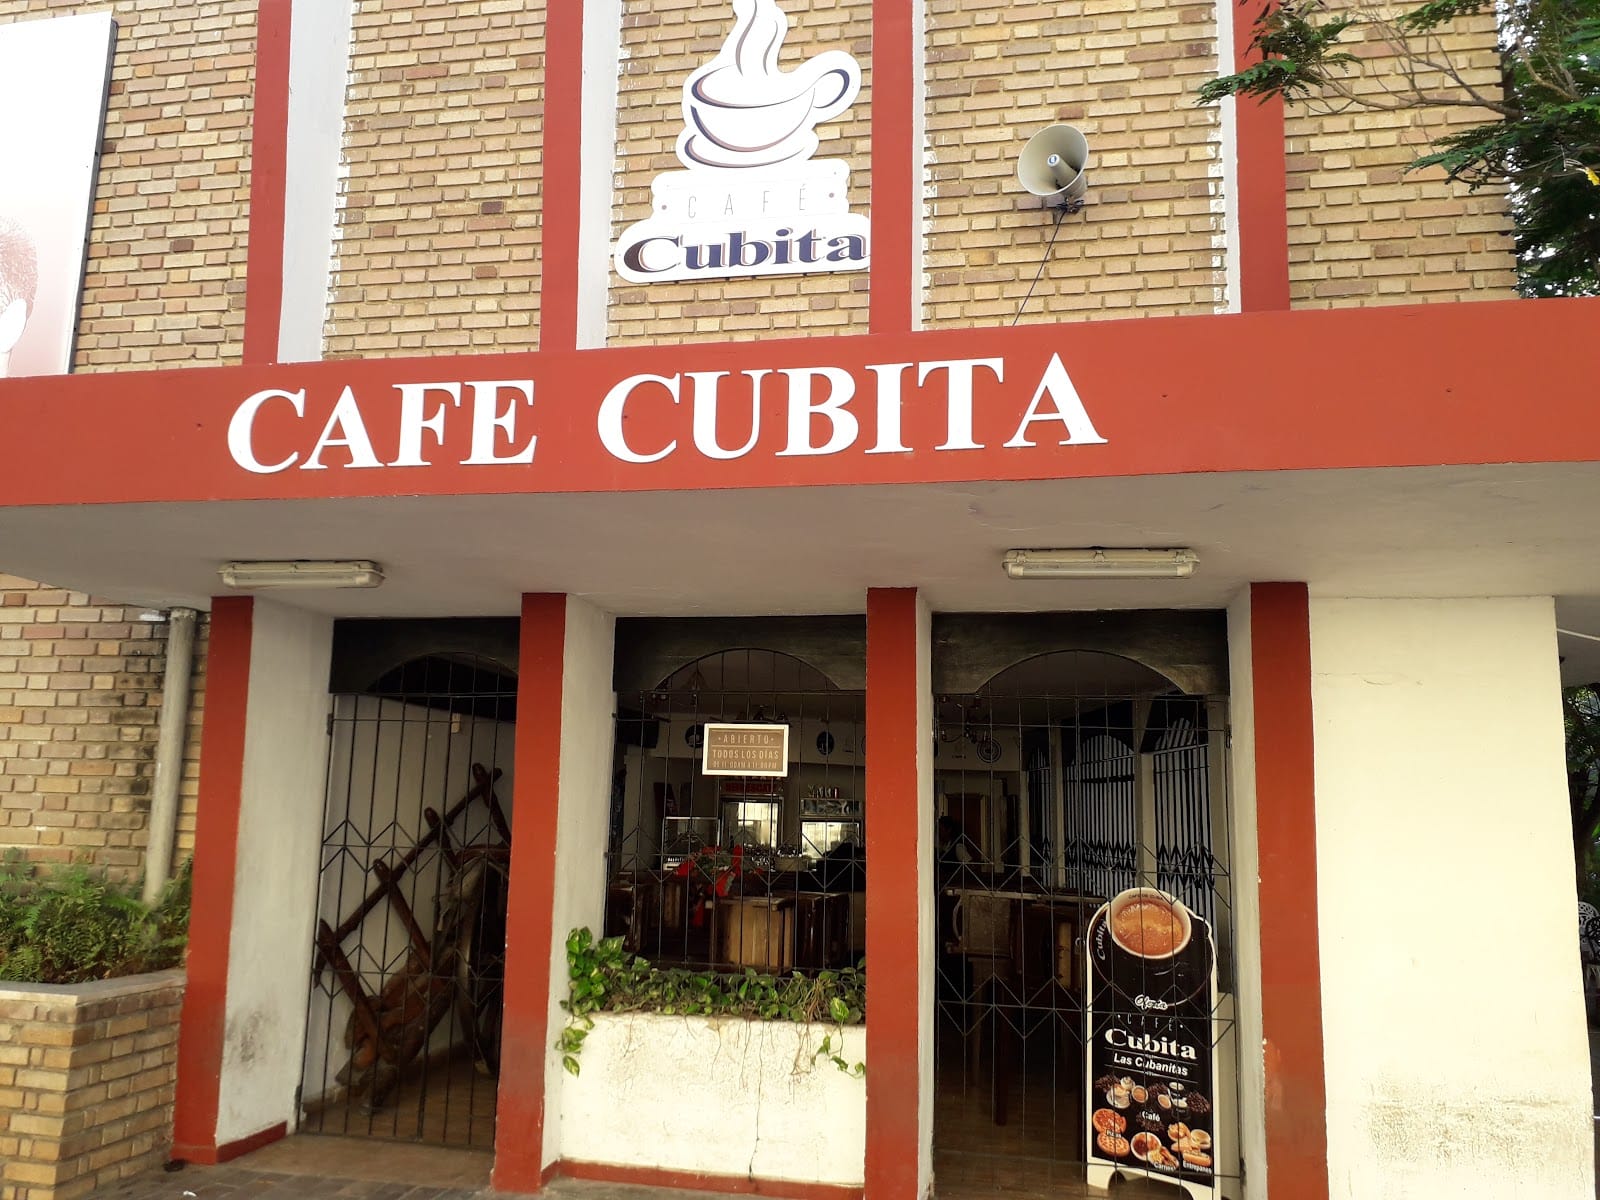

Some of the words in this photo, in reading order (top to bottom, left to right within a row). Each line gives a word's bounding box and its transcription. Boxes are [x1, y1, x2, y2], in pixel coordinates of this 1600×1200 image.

[688, 183, 807, 218] CAFÉ
[623, 226, 869, 274] Cubita
[226, 378, 538, 475] CAFE
[596, 351, 1109, 465] CUBITA
[712, 749, 739, 759] TODOS
[741, 750, 757, 759] LOS
[759, 749, 779, 760] DÍAS
[723, 734, 769, 744] ABIERTO
[1095, 917, 1108, 961] Cubita
[1104, 1027, 1197, 1060] Cubita
[1113, 1053, 1133, 1066] Las
[1135, 1056, 1189, 1077] Cubanitas
